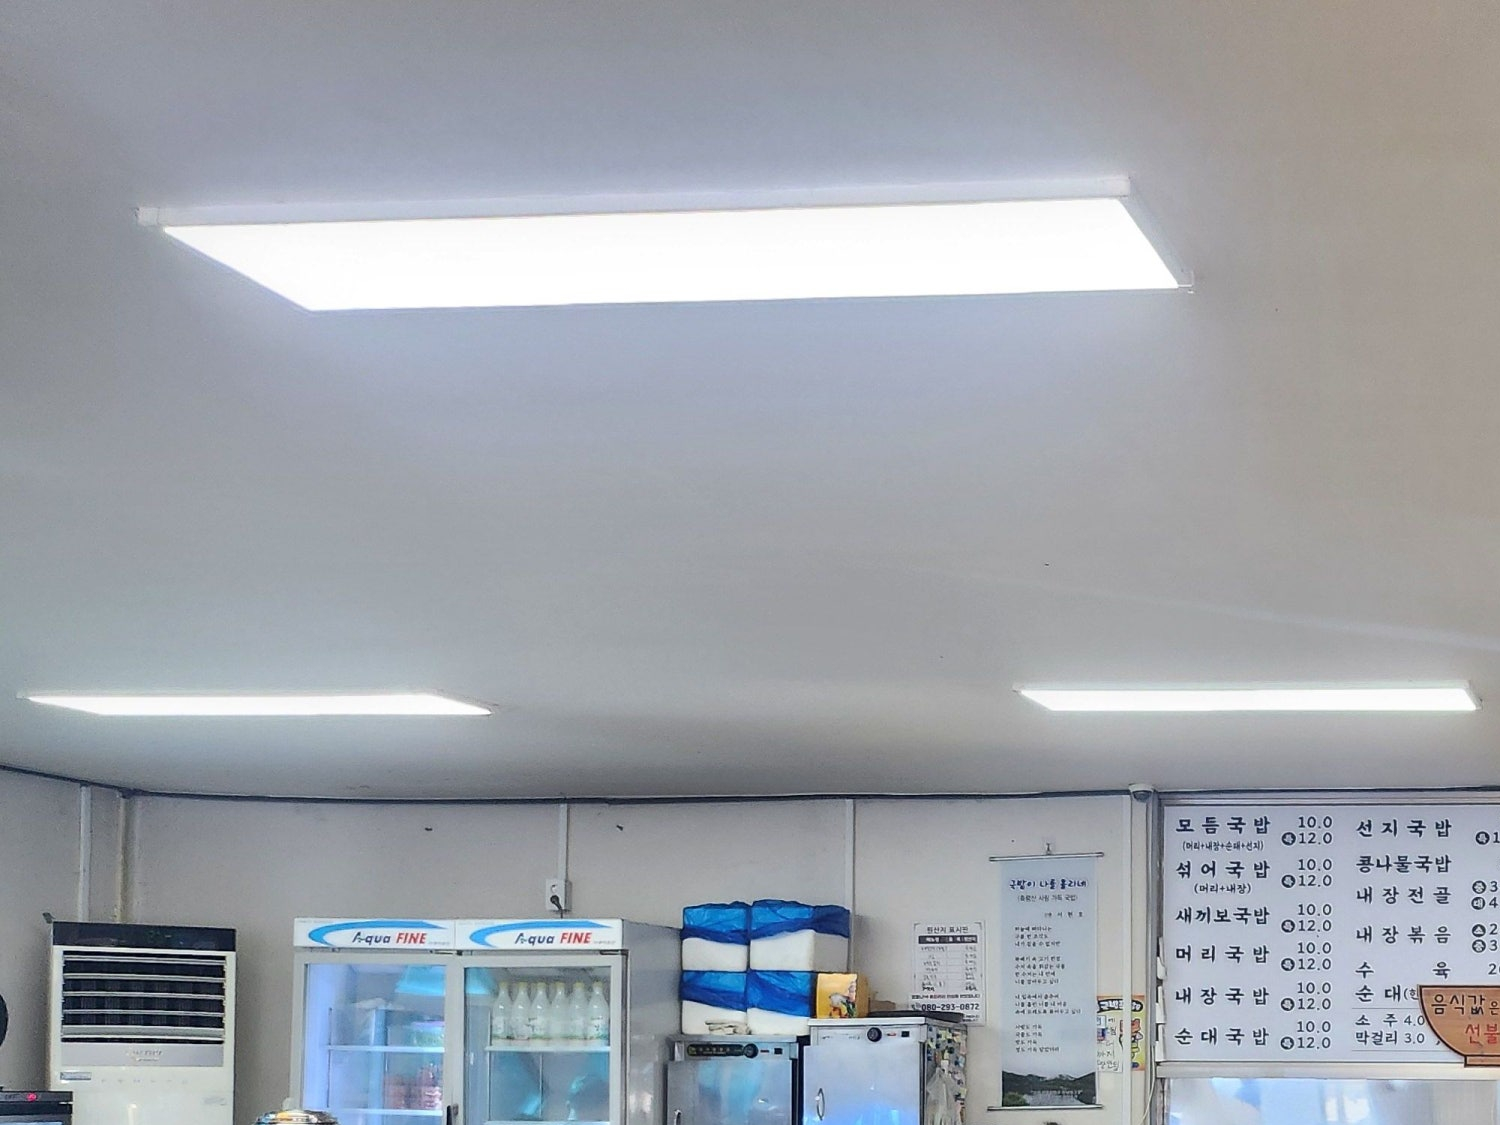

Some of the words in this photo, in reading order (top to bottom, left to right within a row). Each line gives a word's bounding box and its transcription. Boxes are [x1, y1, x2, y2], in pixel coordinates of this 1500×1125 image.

[1175, 815, 1271, 835] 모듬국밥
[1298, 816, 1333, 829] 10.0
[1356, 818, 1452, 838] 선지국밥
[1298, 832, 1333, 845] 12.0
[1298, 858, 1333, 872] 10.0
[1356, 854, 1452, 874] 콩나물국밥
[1298, 874, 1333, 888] 12.0
[1194, 883, 1252, 895] (머리+내장)
[1356, 886, 1451, 905] 내장전골
[1175, 906, 1271, 925] 새끼보국밥
[1297, 903, 1332, 916] 10.0
[1298, 919, 1332, 932] 12.0
[352, 932, 391, 946] Aqua
[396, 932, 427, 945] FINE
[514, 932, 554, 946] Aqua
[560, 932, 592, 945] FINE
[1356, 925, 1451, 945] 내장볶음
[1175, 945, 1270, 964] 머리국밥
[1297, 942, 1332, 955] 10.0
[1297, 958, 1332, 971] 12.0
[1175, 987, 1269, 1006] 내장국밥
[1297, 982, 1332, 995] 10.0
[922, 1003, 980, 1011] 080-293-0872
[1297, 998, 1332, 1011] 12.0
[1403, 1015, 1425, 1026] 4.0
[1174, 1027, 1269, 1046] 순대국밥
[1296, 1021, 1332, 1034] 10.0
[1355, 1030, 1398, 1046] 막걸리
[1404, 1033, 1425, 1044] 3.0
[1297, 1037, 1332, 1050] 12.0
